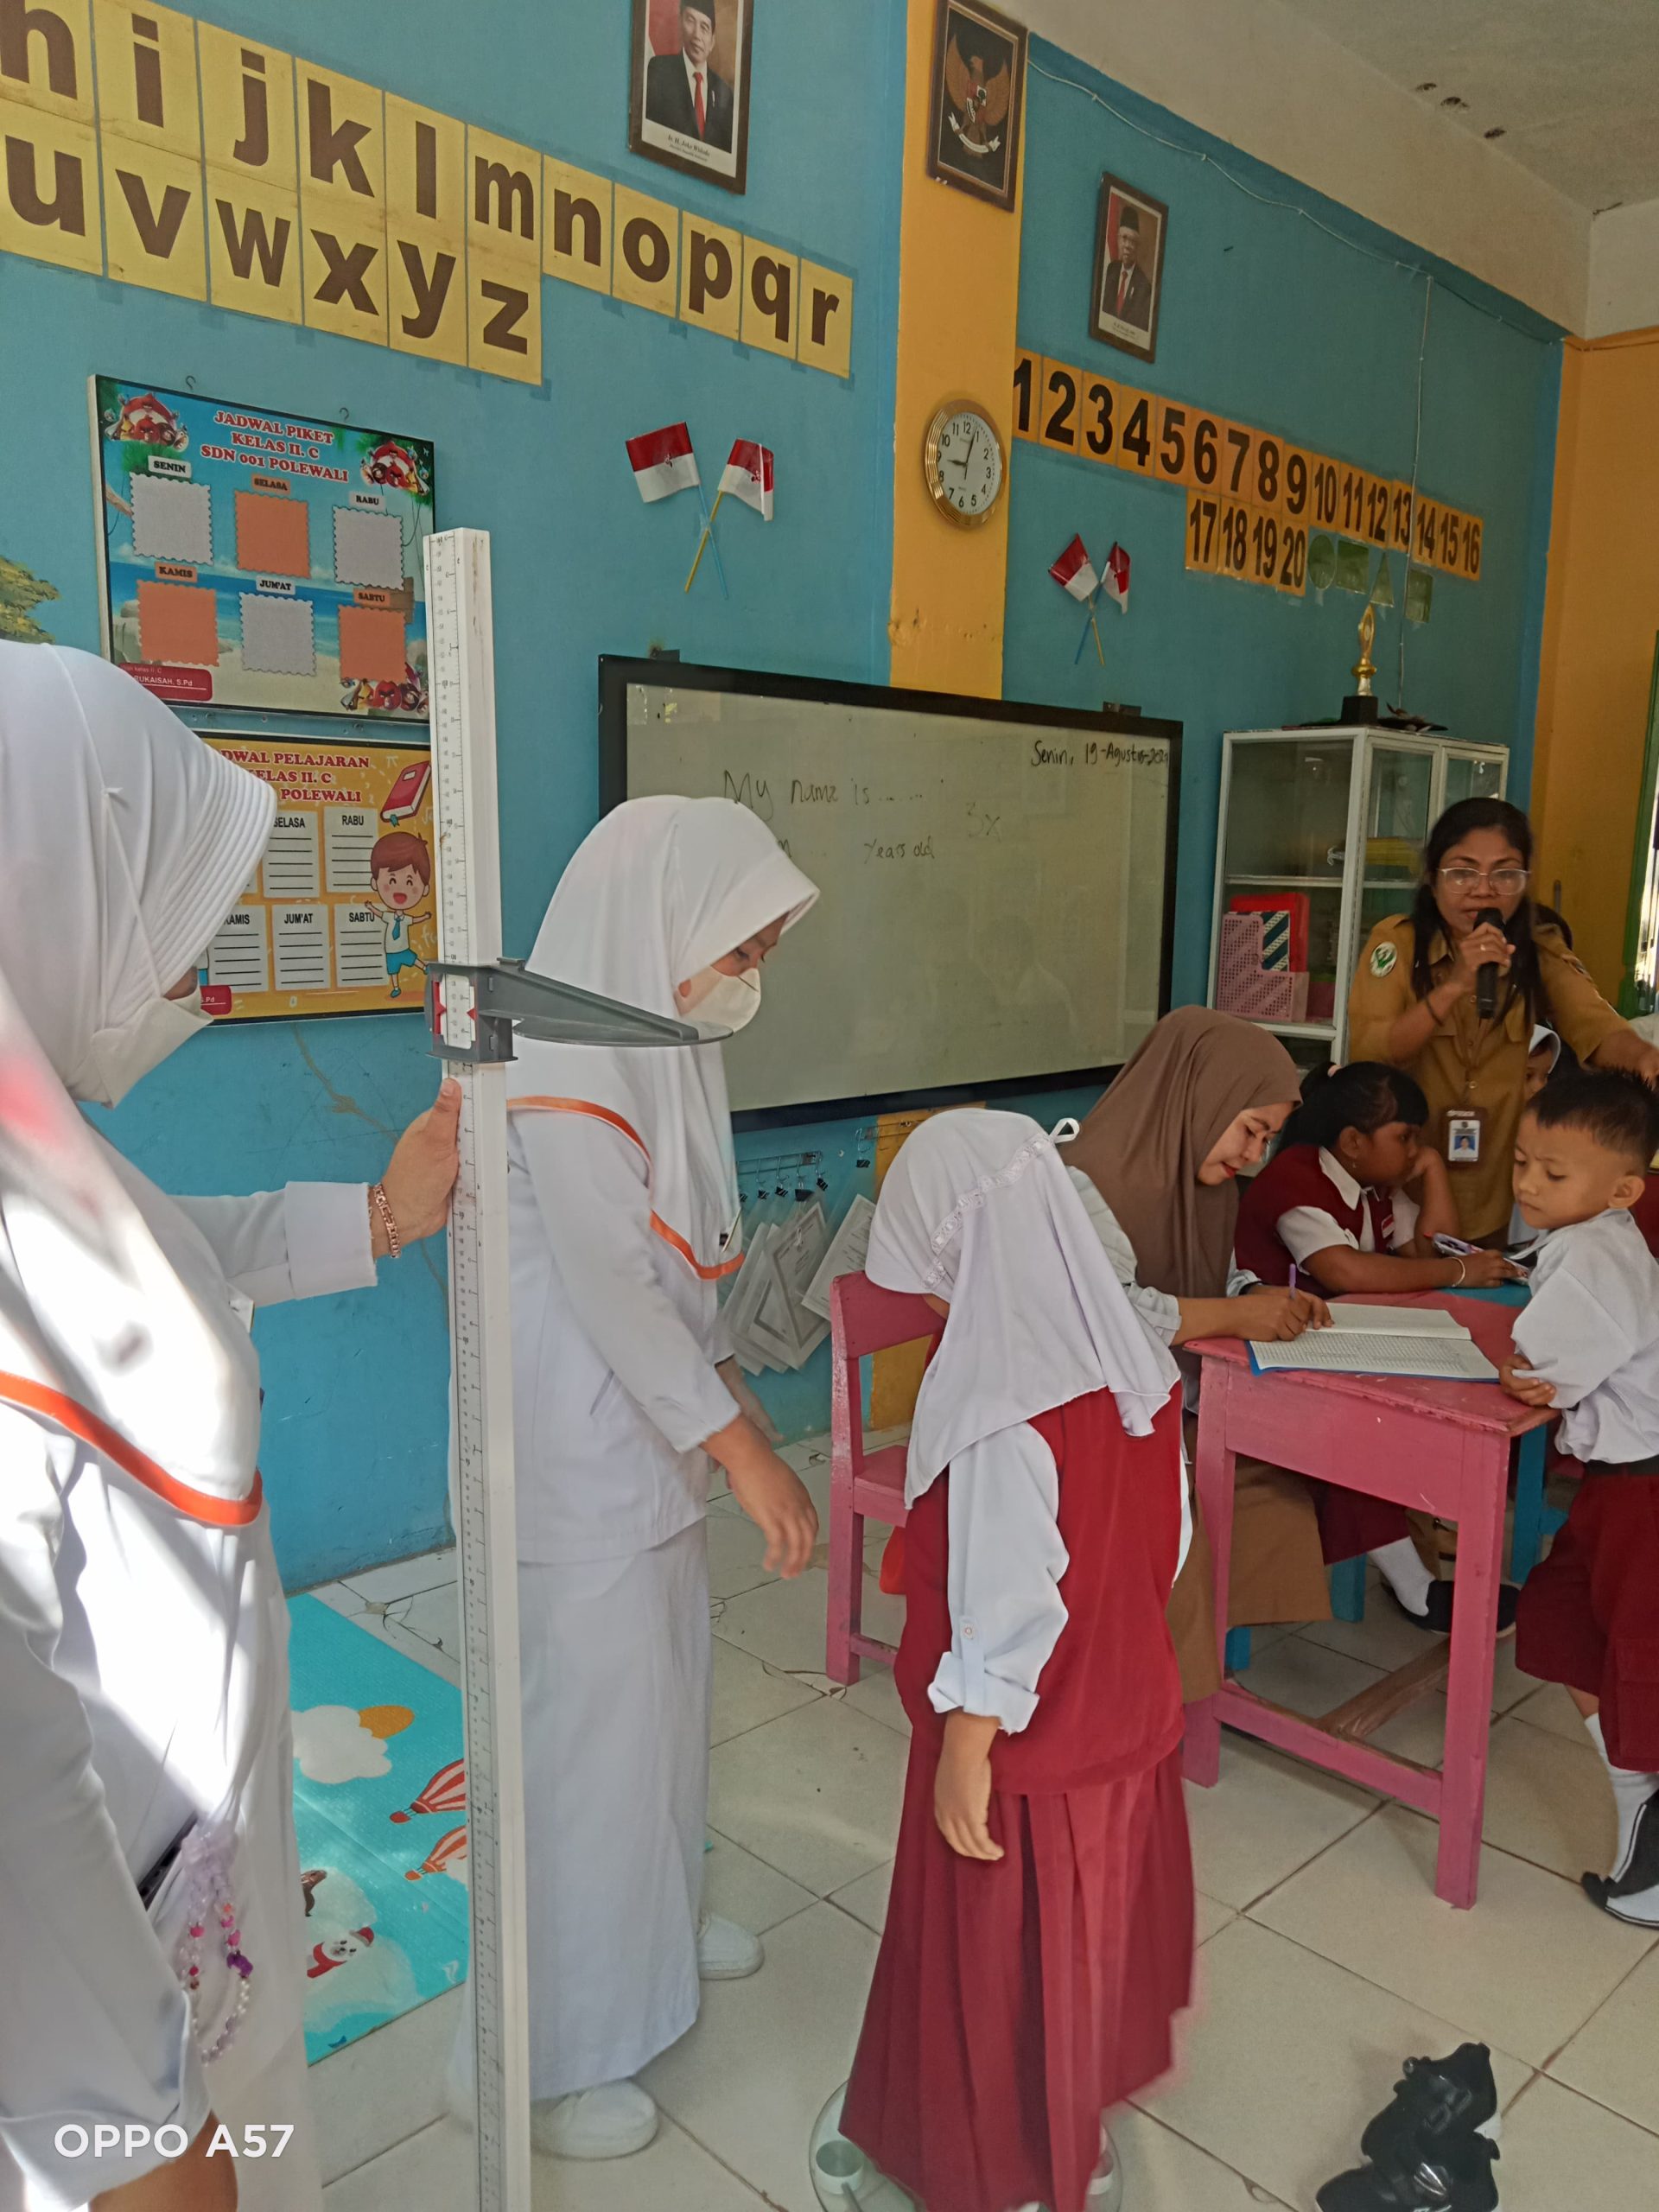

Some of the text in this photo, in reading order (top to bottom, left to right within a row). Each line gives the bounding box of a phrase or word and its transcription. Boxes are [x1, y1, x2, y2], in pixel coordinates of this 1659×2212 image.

[131, 13, 164, 128] i
[232, 48, 269, 166] j
[308, 79, 375, 198] k
[474, 156, 534, 240] m
[554, 188, 601, 266] n
[622, 217, 670, 283] o
[689, 230, 733, 314] p
[751, 255, 790, 342] q
[811, 287, 839, 346] r
[4, 135, 528, 354] u v w x y z
[215, 411, 334, 444] JADWAL PIKET
[953, 423, 959, 435] 11
[963, 422, 971, 434] 12
[232, 432, 319, 459] KELAS II. C
[942, 435, 950, 447] 10
[983, 448, 988, 460] 2
[154, 461, 186, 473] SENIN
[201, 445, 348, 482] SDN 001 POLEWALI
[1013, 358, 1481, 575] 1 2 3 4 5 6 7 8 9 10 11 12 13 14 15 16
[939, 471, 944, 482] 8
[986, 467, 991, 479] 3
[949, 487, 954, 499] 7
[982, 484, 986, 495] 4
[356, 495, 379, 505] RABU
[959, 496, 964, 507] 6
[971, 495, 976, 506] 5
[1190, 499, 1305, 588] 17 18 19 20
[159, 567, 193, 578] KAMIS
[259, 580, 291, 591] JUM'AT
[358, 592, 385, 603] SABTU
[220, 750, 369, 768] DWAL PELAJARAN
[248, 769, 332, 784] ELAS II. C
[281, 788, 361, 803] POLEWALI
[724, 769, 774, 822] My
[274, 817, 305, 828] SELASA
[342, 815, 364, 825] RABU
[284, 912, 313, 924] JUM'AT
[349, 912, 375, 922] SABTU
